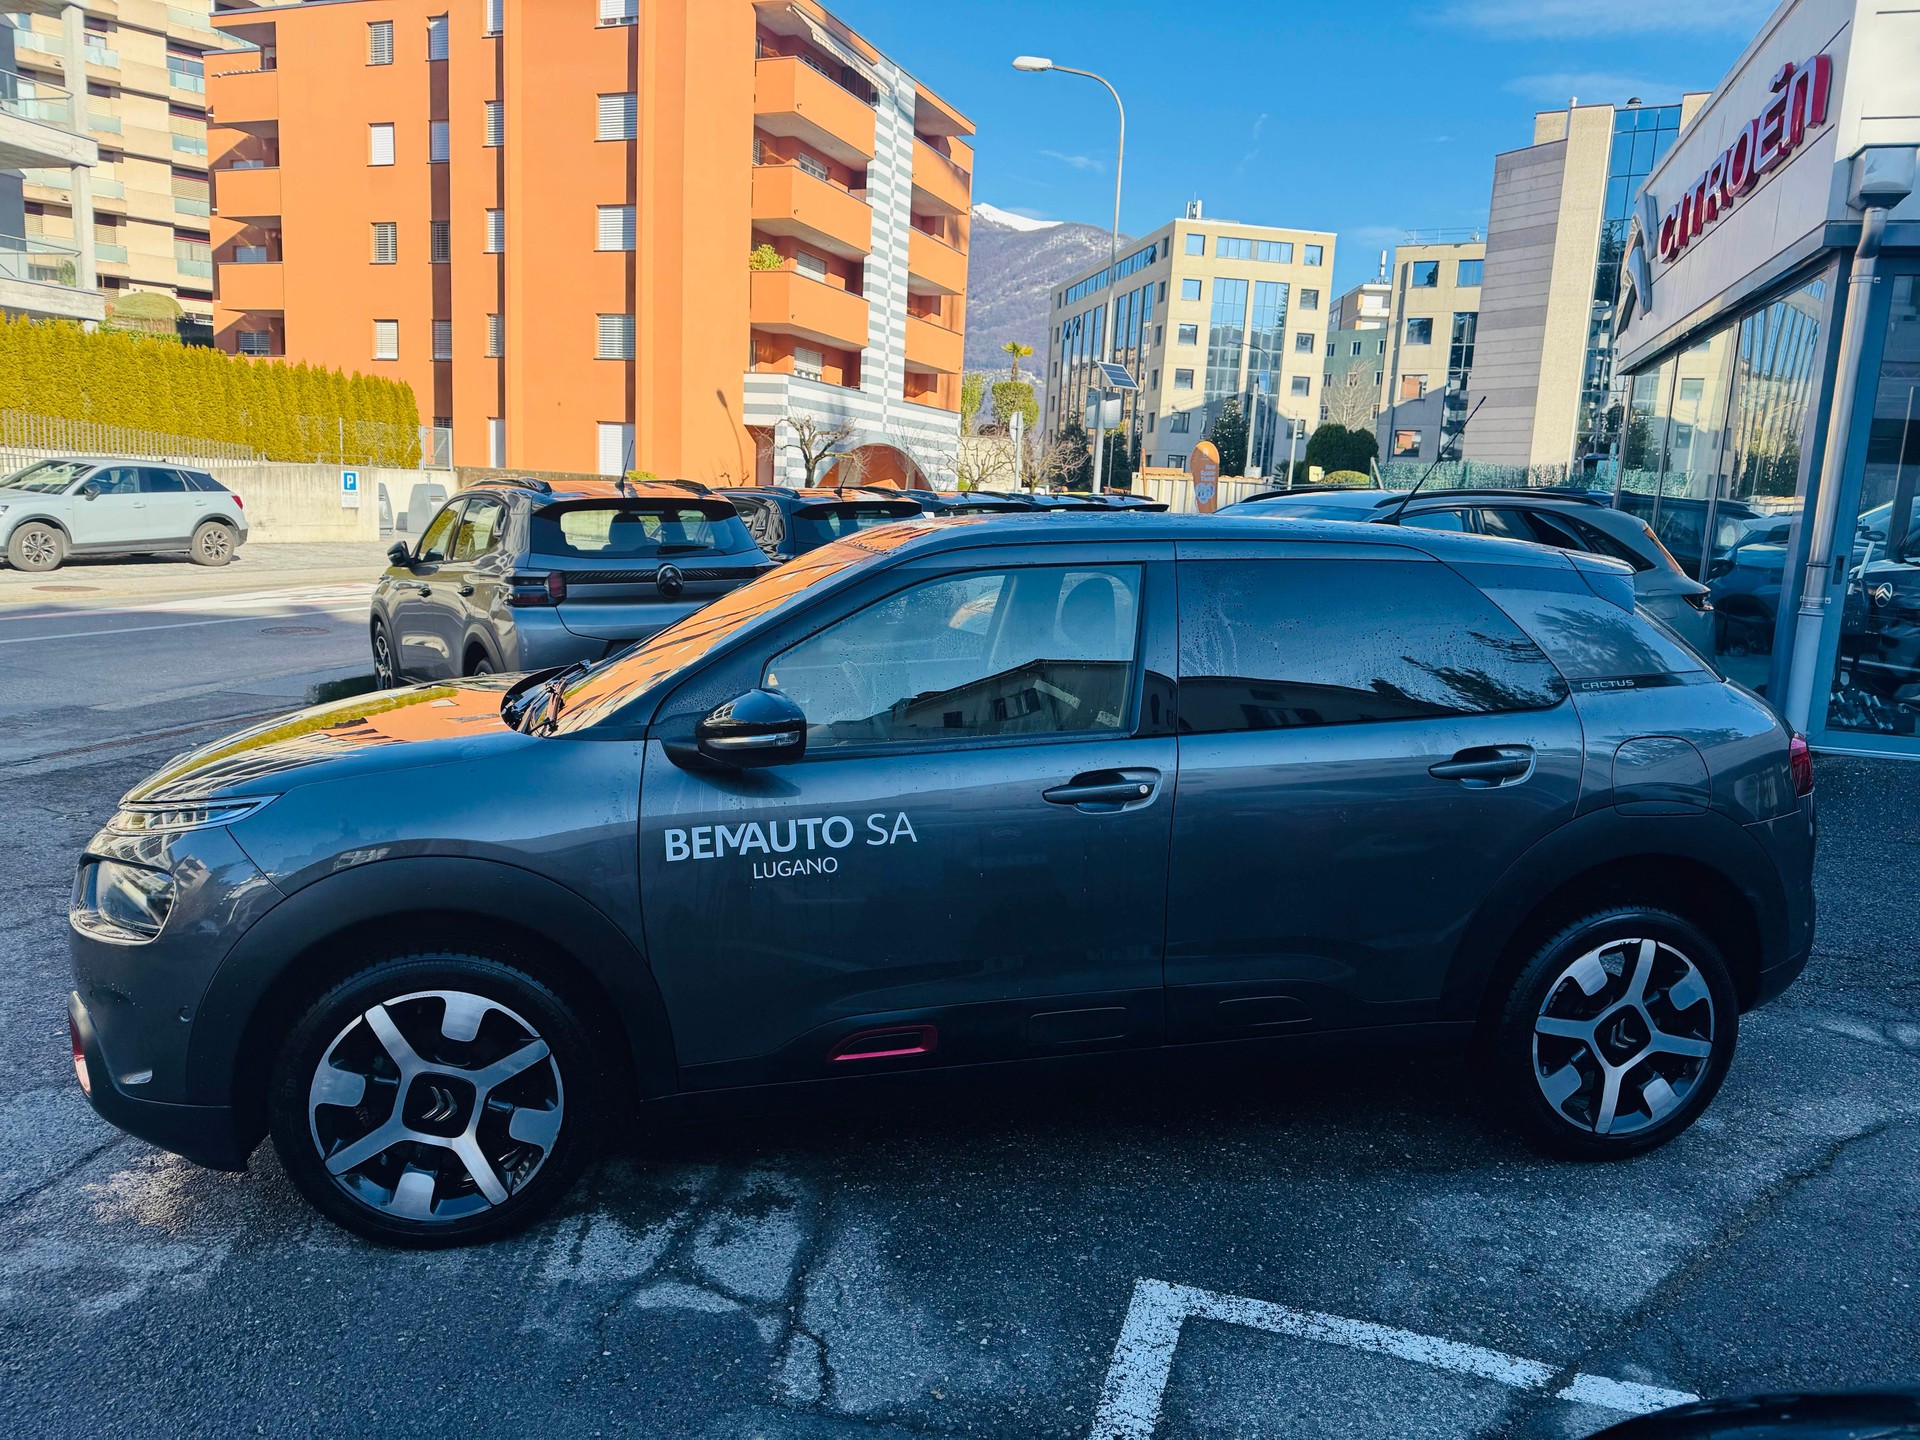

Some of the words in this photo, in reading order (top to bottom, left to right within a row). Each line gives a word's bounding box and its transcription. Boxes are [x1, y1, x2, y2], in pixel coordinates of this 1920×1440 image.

[347, 475, 354, 488] P
[1582, 680, 1635, 690] CACTUS
[866, 811, 918, 845] SA
[753, 856, 838, 879] LUGANO
